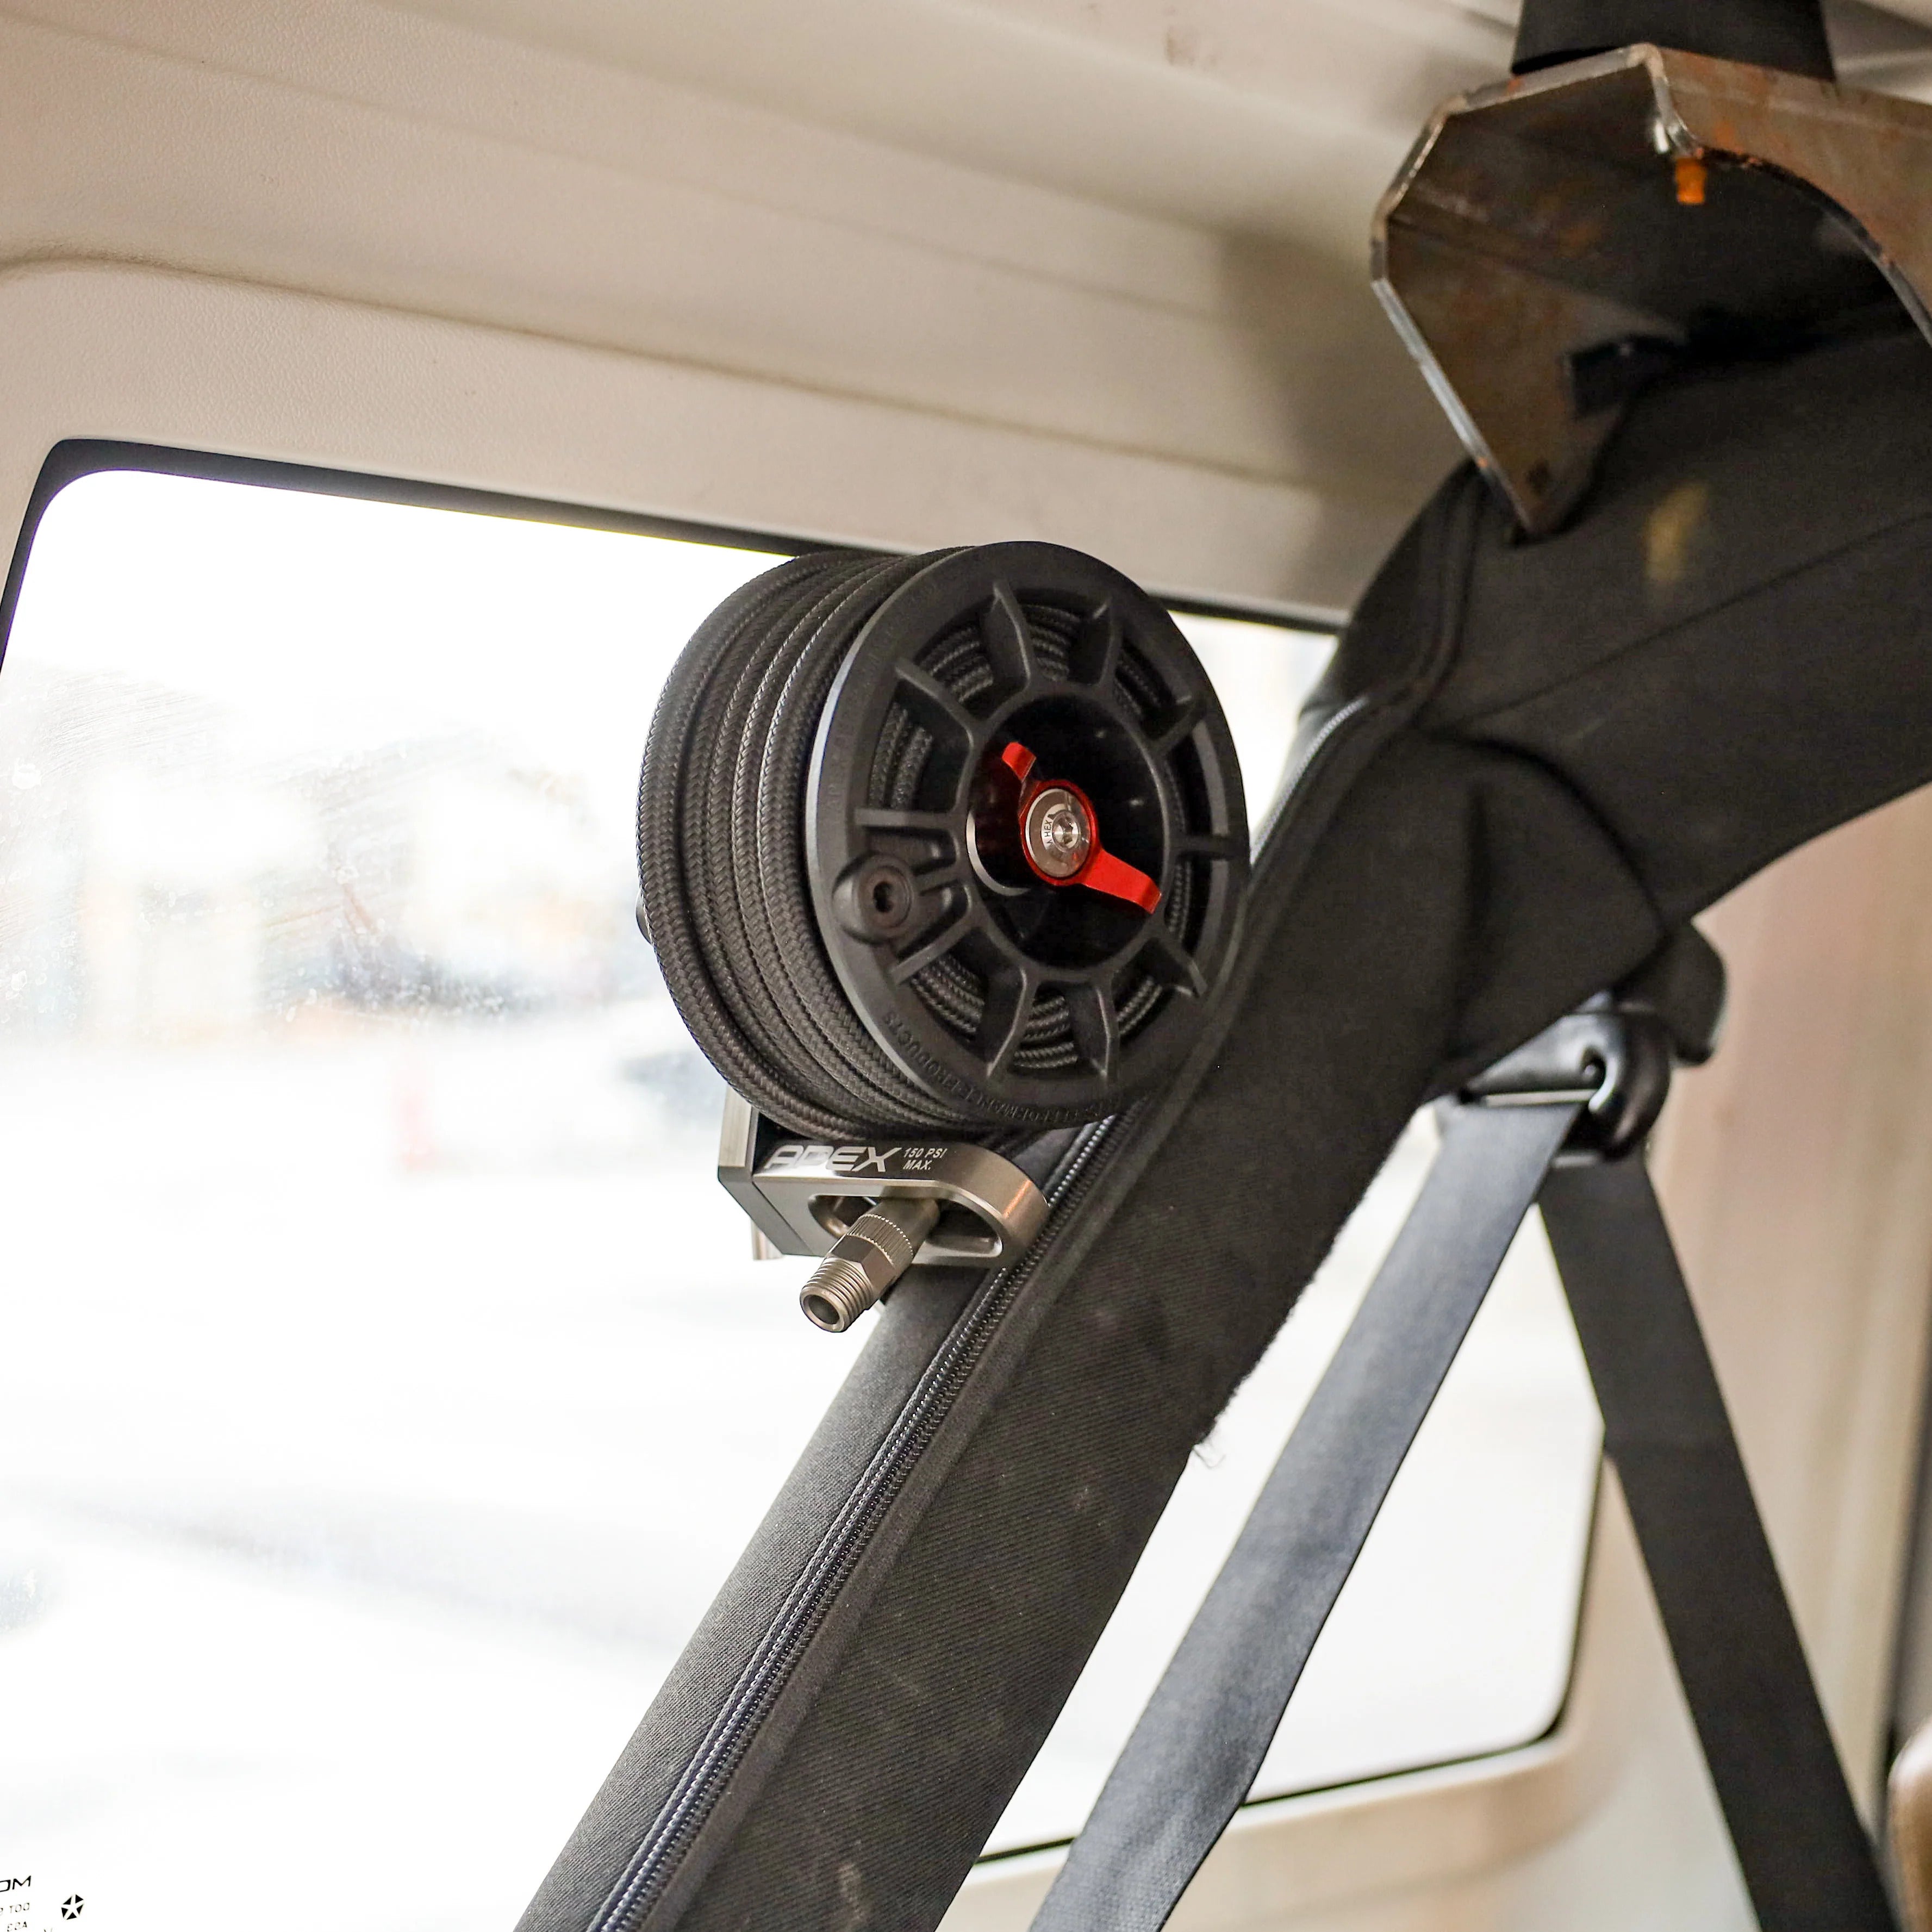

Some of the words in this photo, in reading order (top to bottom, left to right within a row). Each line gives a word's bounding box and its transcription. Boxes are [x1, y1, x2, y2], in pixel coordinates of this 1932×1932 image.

[1044, 820, 1052, 837] HEX
[882, 1010, 961, 1093] PRODUCTS
[764, 1145, 902, 1172] APEX
[903, 1147, 924, 1158] 150
[924, 1148, 948, 1158] PSI
[902, 1160, 932, 1170] MAX.
